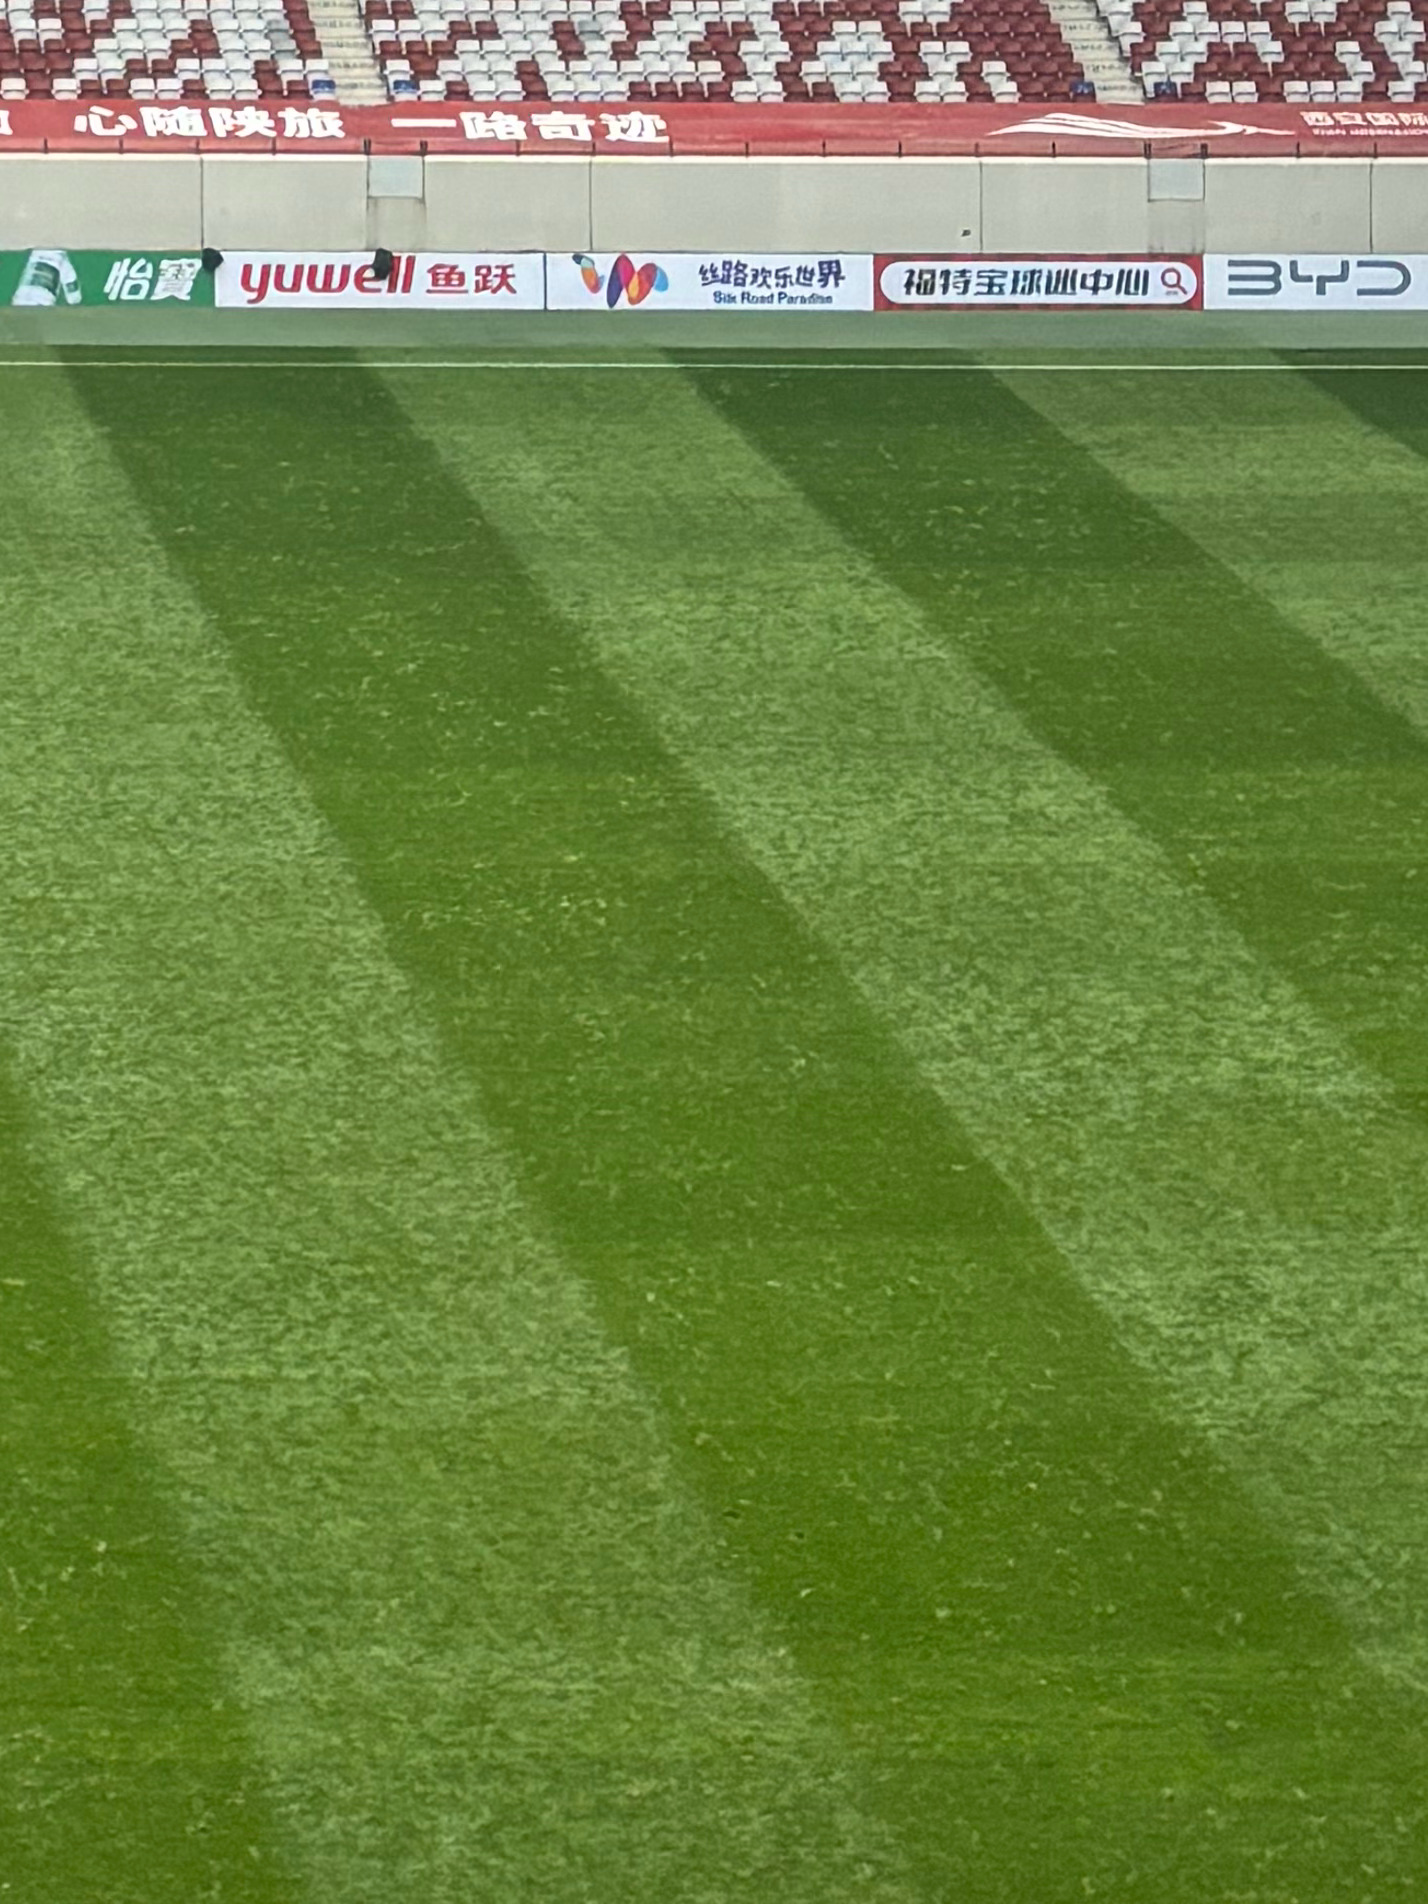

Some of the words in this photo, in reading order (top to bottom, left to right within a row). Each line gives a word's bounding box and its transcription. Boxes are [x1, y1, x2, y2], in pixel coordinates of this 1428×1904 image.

[73, 105, 345, 138] 心随陕旅
[392, 110, 669, 143] 一路奇迹
[240, 255, 416, 304] yuwell
[426, 263, 518, 294] 鱼跃
[699, 259, 846, 289] 丝路欢乐世界
[903, 267, 1150, 296] 福特宝球迷中心
[1227, 259, 1412, 296] BYD
[741, 291, 774, 304] Road
